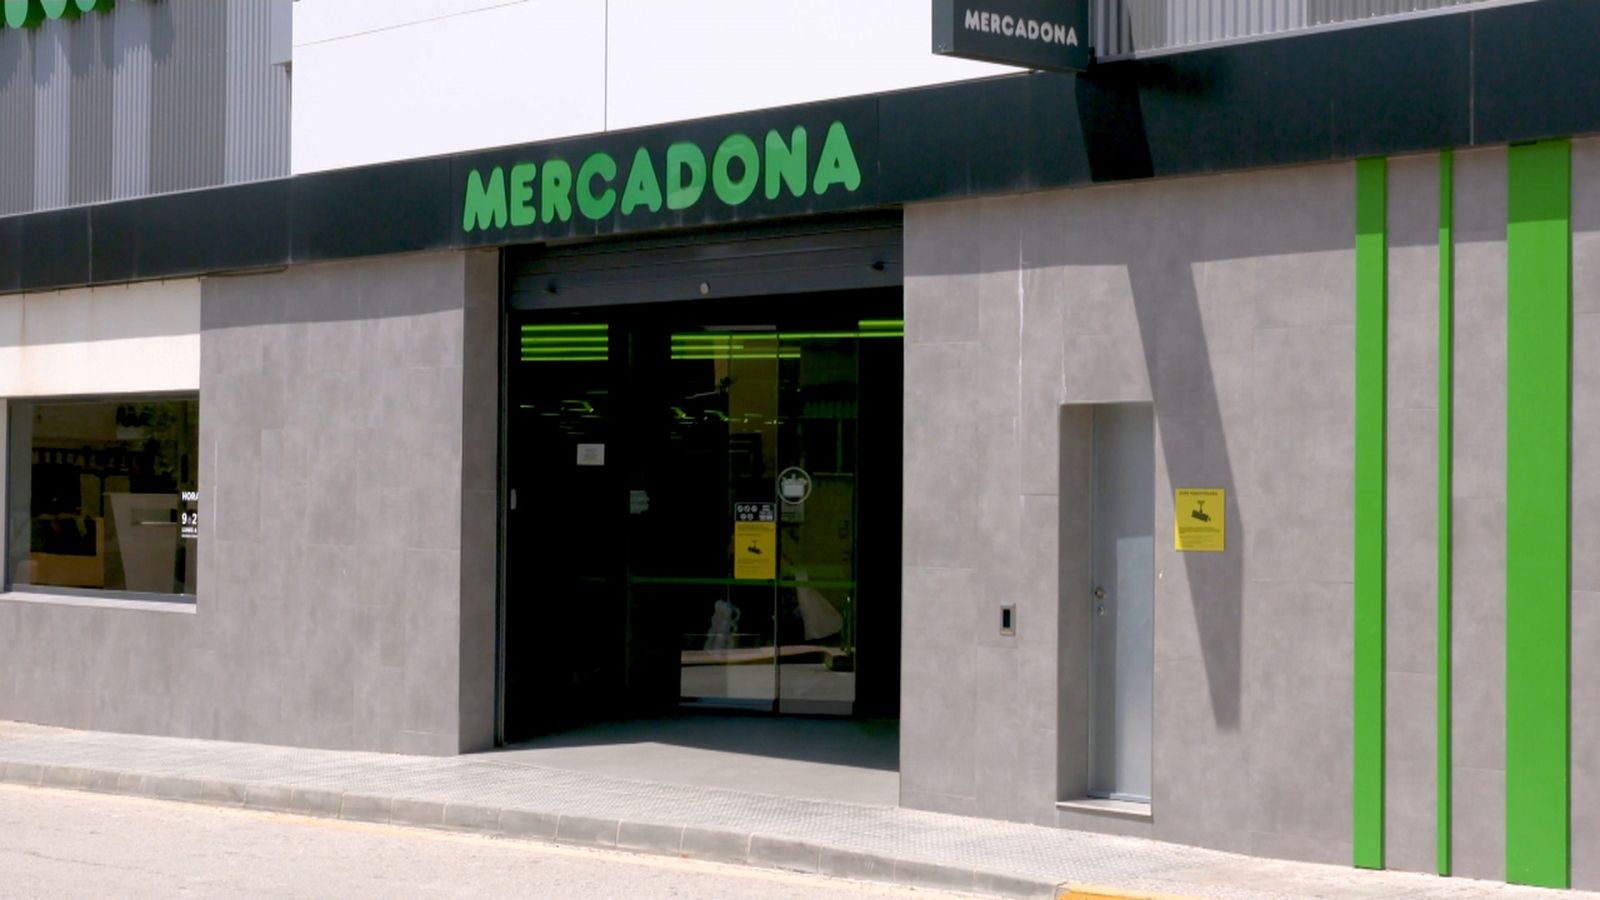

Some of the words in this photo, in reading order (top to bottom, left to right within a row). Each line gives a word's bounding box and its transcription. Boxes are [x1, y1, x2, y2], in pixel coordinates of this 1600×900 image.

[964, 9, 1078, 46] MERCADONA
[463, 120, 861, 232] MERCADONA
[182, 513, 187, 525] 9
